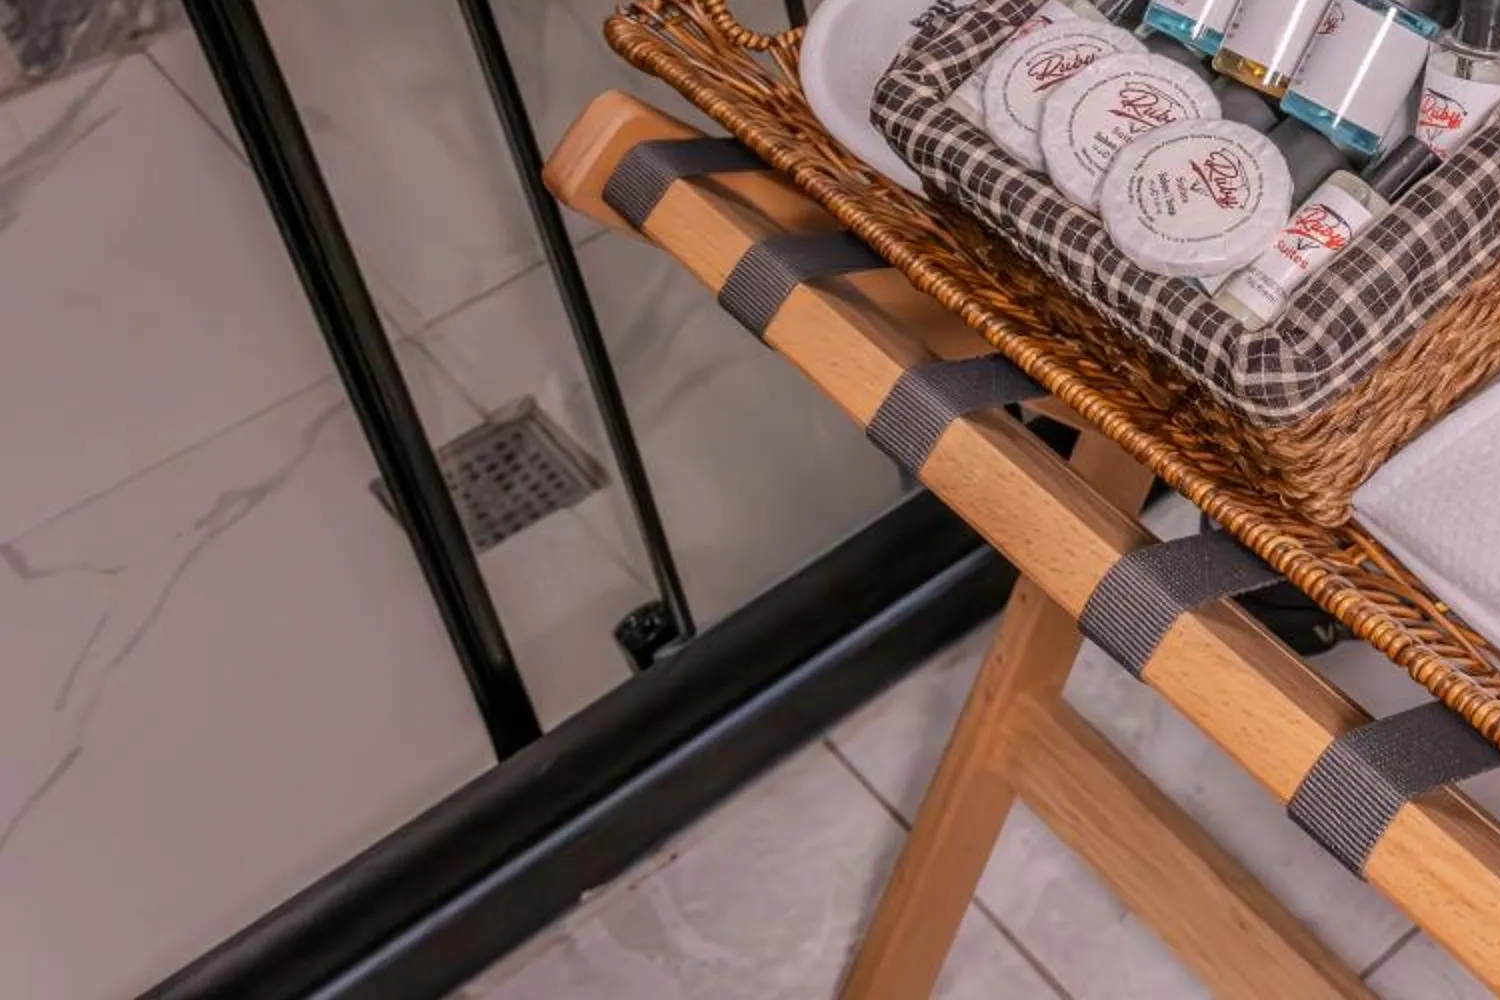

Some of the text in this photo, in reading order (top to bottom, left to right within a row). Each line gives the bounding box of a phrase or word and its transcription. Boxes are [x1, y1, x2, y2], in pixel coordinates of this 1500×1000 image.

[1418, 93, 1463, 129] Ruby
[1189, 151, 1239, 209] Ruby
[1284, 203, 1346, 250] Ruby
[1274, 239, 1309, 270] Suites
